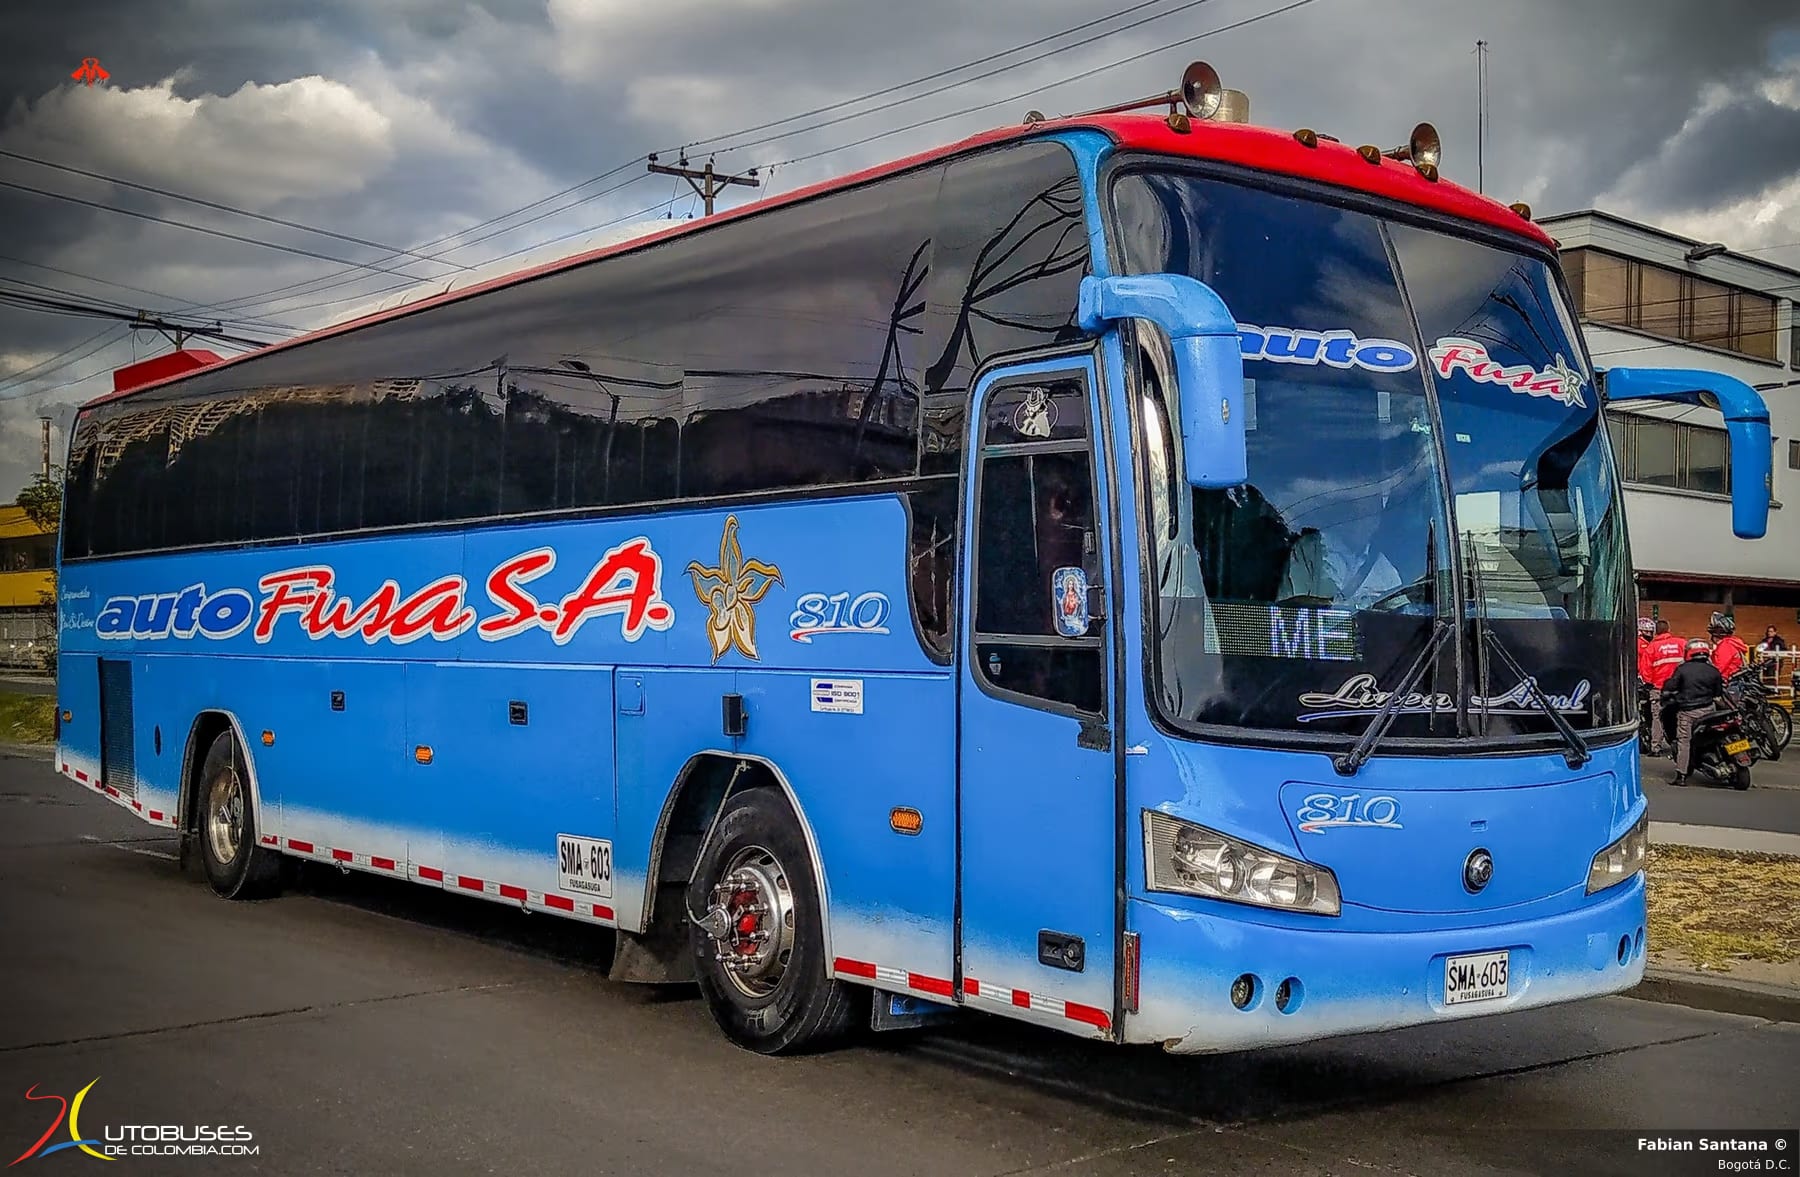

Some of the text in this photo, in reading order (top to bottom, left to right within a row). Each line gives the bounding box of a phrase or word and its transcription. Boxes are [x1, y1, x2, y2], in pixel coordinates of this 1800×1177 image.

[1429, 337, 1568, 402] Fusa
[96, 536, 675, 646] auto Fusa S.A.
[789, 591, 891, 631] 810
[1269, 605, 1354, 661] ME
[1470, 676, 1591, 710] Aul
[1297, 793, 1404, 826] 810
